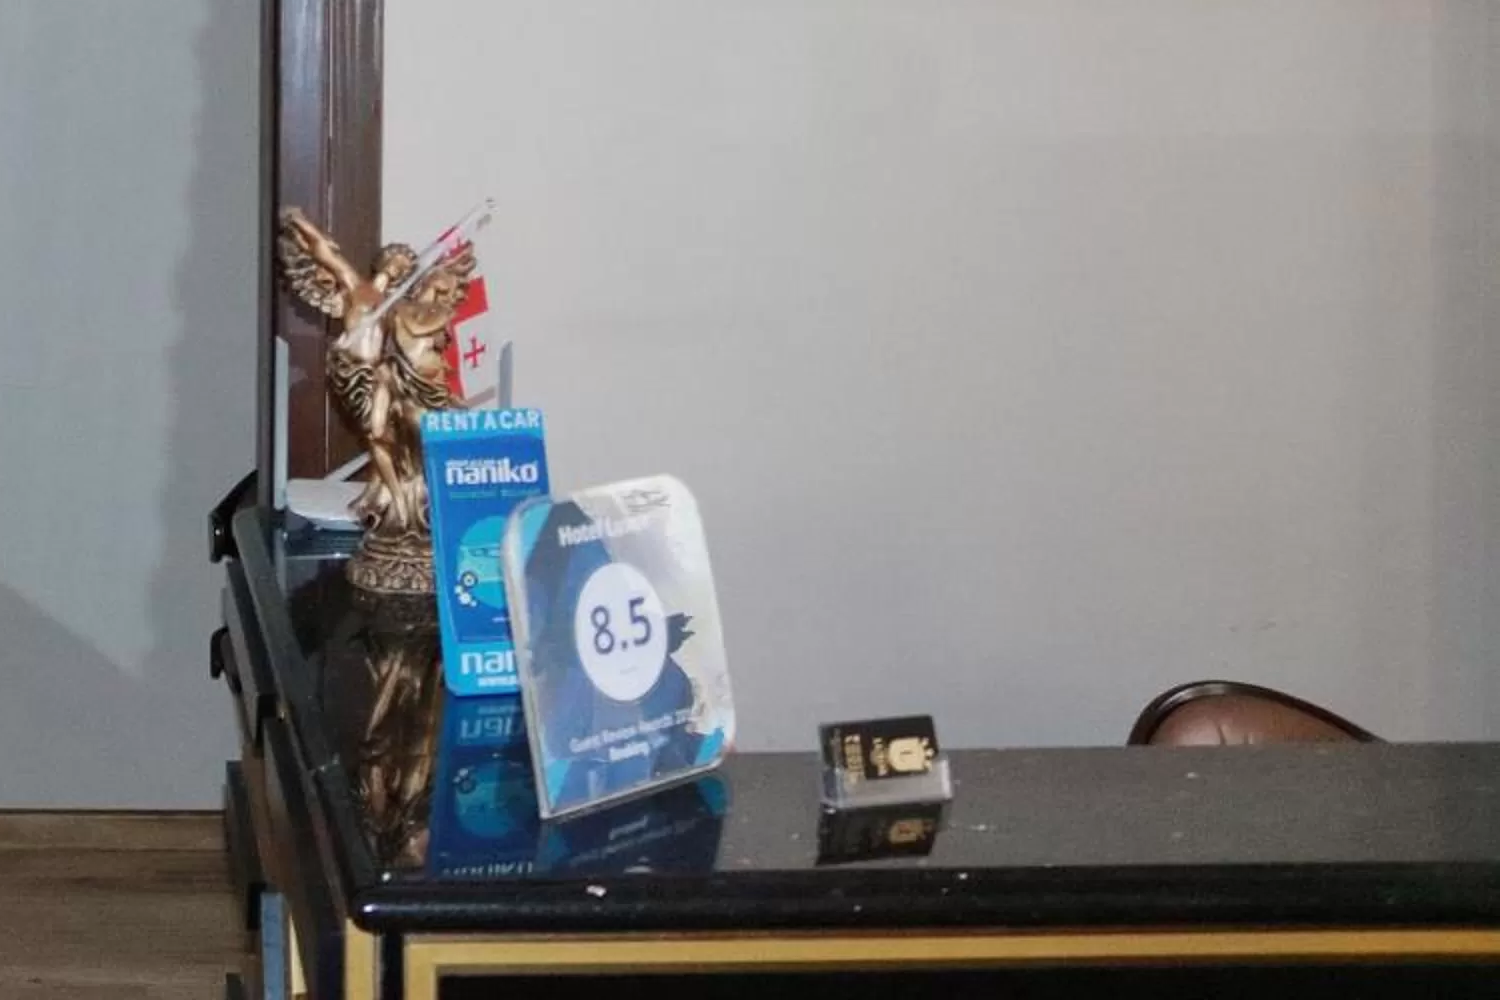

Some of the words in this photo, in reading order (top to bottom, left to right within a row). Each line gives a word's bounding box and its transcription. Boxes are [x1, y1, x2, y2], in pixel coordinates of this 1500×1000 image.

[426, 412, 479, 432] RENT
[484, 412, 497, 431] A
[499, 410, 541, 430] CAR
[446, 457, 539, 485] naniko
[591, 596, 651, 655] 8.5
